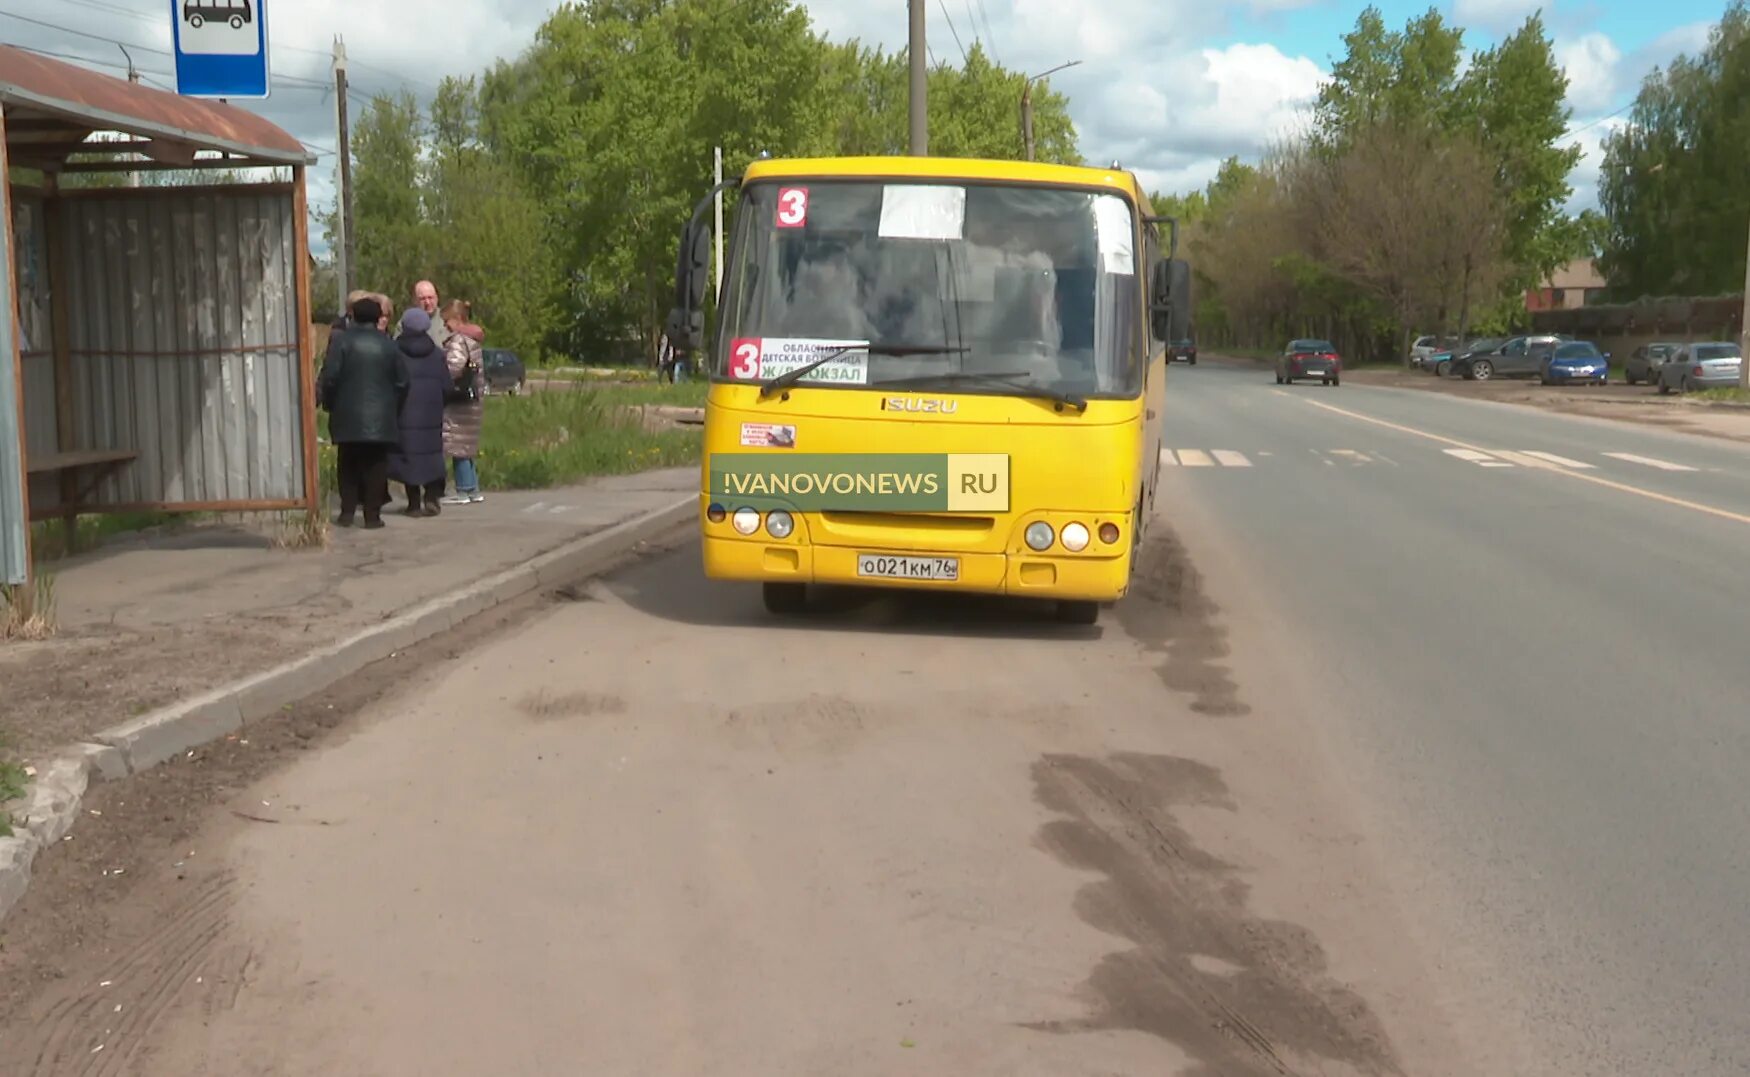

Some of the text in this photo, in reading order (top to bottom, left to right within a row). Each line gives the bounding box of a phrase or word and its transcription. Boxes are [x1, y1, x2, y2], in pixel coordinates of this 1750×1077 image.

[780, 189, 805, 225] 3
[734, 343, 758, 379] 3
[762, 353, 861, 365] ДЕТСКАЯ БОЛНИЦА
[881, 397, 958, 414] ISUZU
